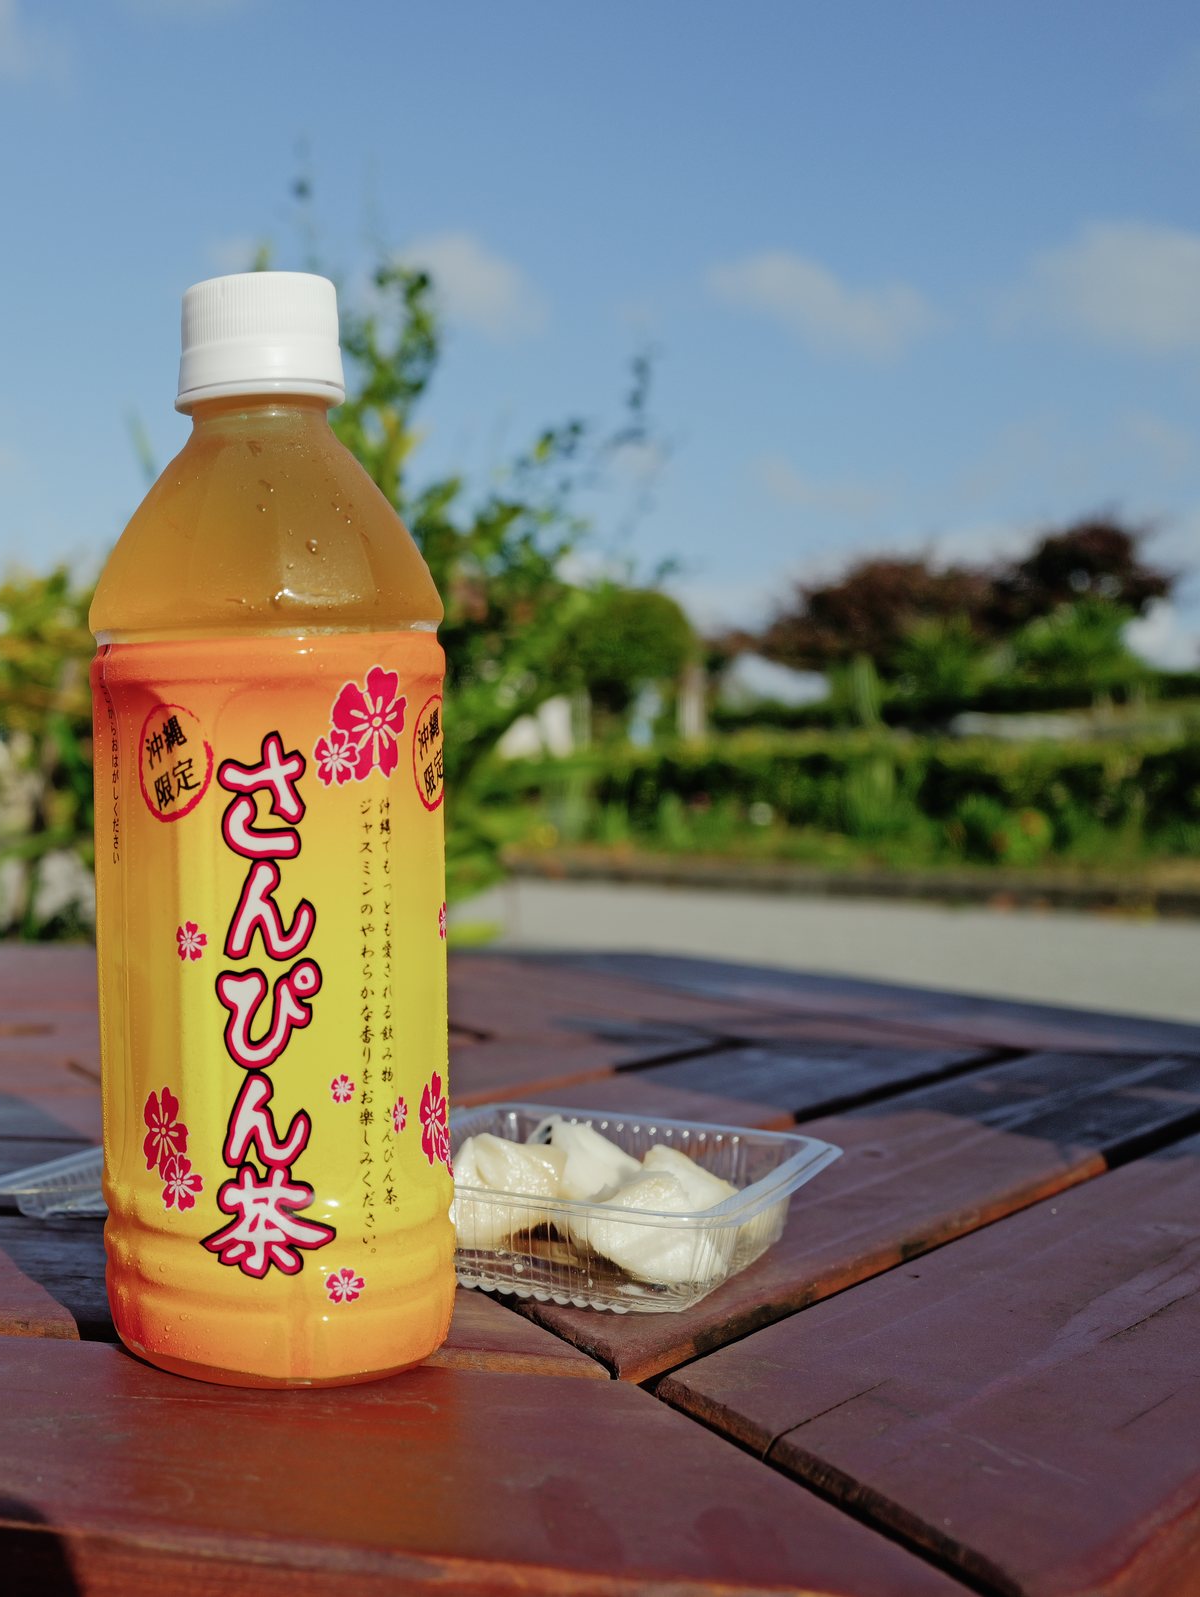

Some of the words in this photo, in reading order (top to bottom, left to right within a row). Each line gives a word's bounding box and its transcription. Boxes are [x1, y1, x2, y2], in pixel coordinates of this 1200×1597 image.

[145, 715, 188, 770] 沖縄
[417, 707, 440, 761] 沖縄
[154, 758, 201, 811] 限定
[199, 730, 337, 1280] さんぴん茶
